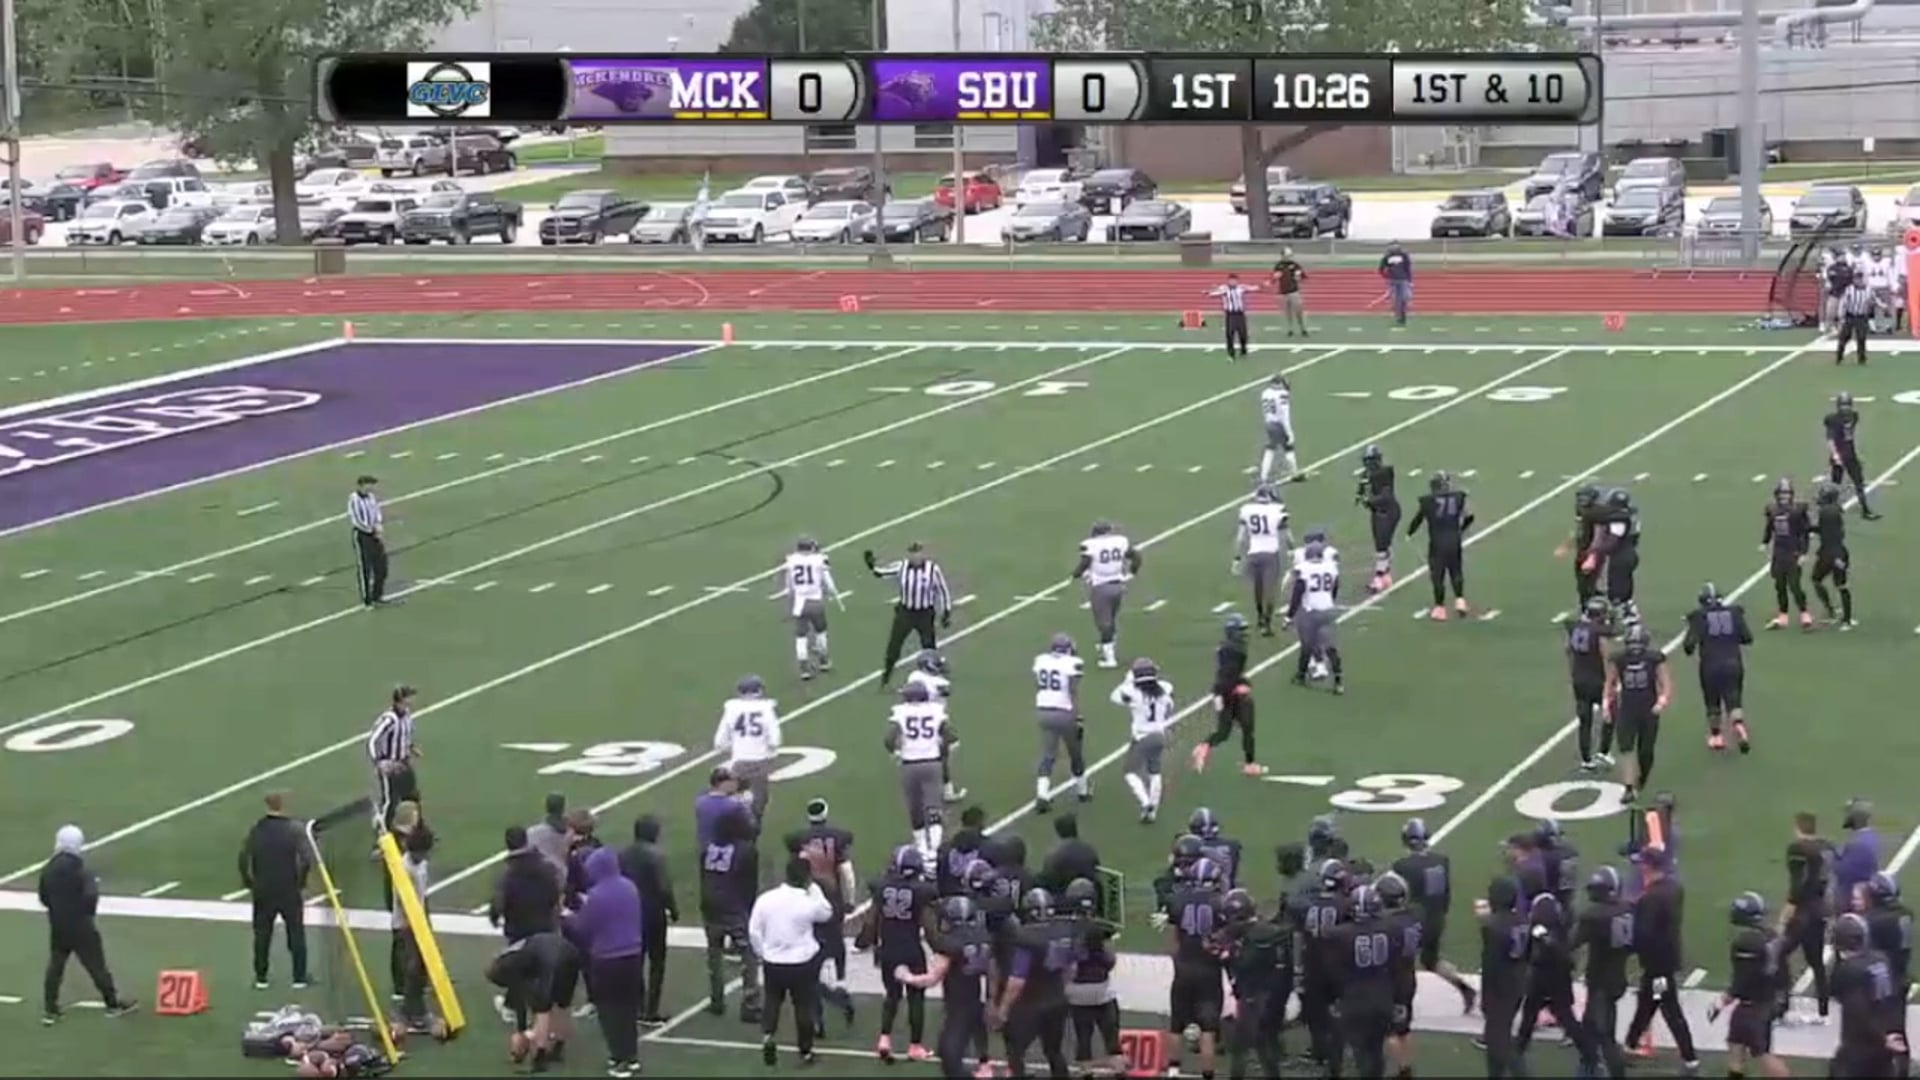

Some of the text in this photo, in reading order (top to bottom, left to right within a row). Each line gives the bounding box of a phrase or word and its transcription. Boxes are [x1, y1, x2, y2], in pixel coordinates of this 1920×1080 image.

[1249, 514, 1271, 535] 91
[793, 565, 815, 585] 21
[1310, 572, 1333, 592] 38
[1038, 669, 1061, 691] 96
[1147, 702, 1156, 722] 1
[734, 712, 763, 737] 45
[905, 715, 934, 739] 55
[705, 843, 735, 871] 23
[883, 888, 912, 919] 32
[1181, 903, 1213, 936] 40
[160, 975, 194, 1008] 20
[1121, 1034, 1157, 1071] 30
